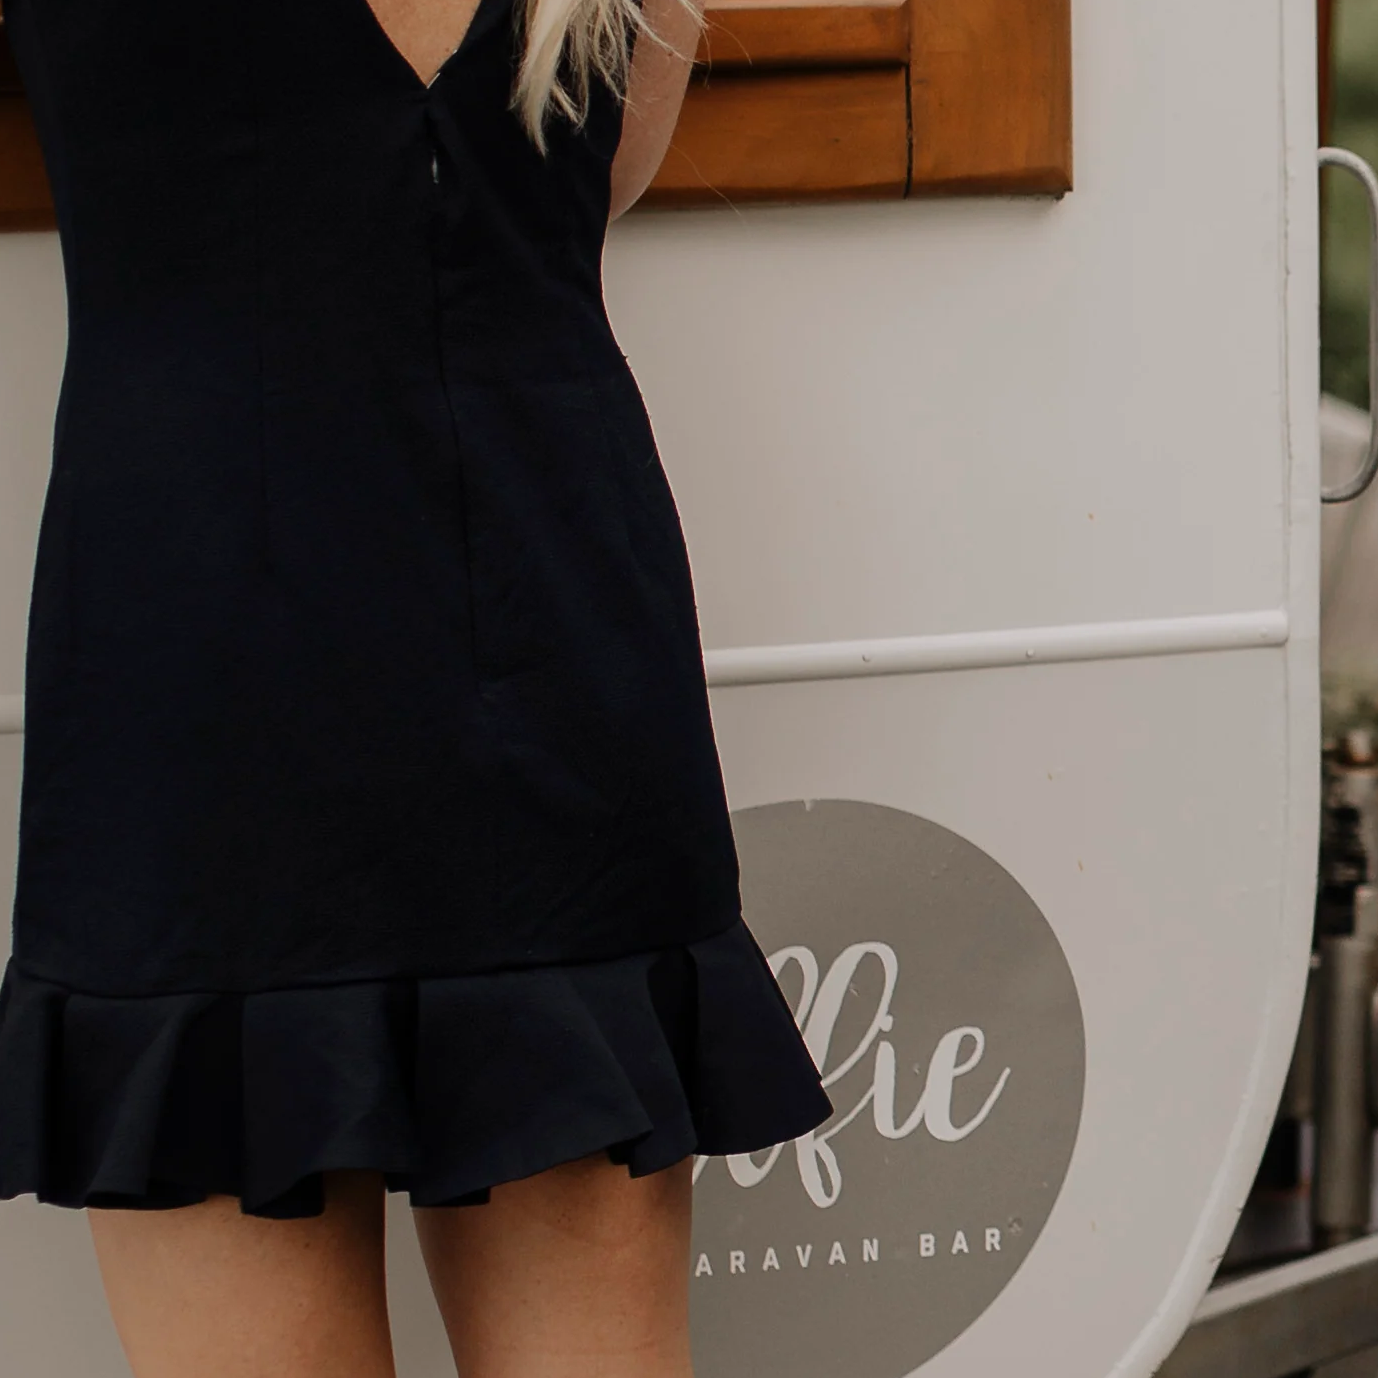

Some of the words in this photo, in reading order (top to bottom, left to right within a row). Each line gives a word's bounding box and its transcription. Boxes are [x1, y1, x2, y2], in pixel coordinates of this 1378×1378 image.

[692, 941, 1011, 1208] lfie
[694, 1238, 879, 1277] ARAVAN
[919, 1227, 1002, 1258] BAR
